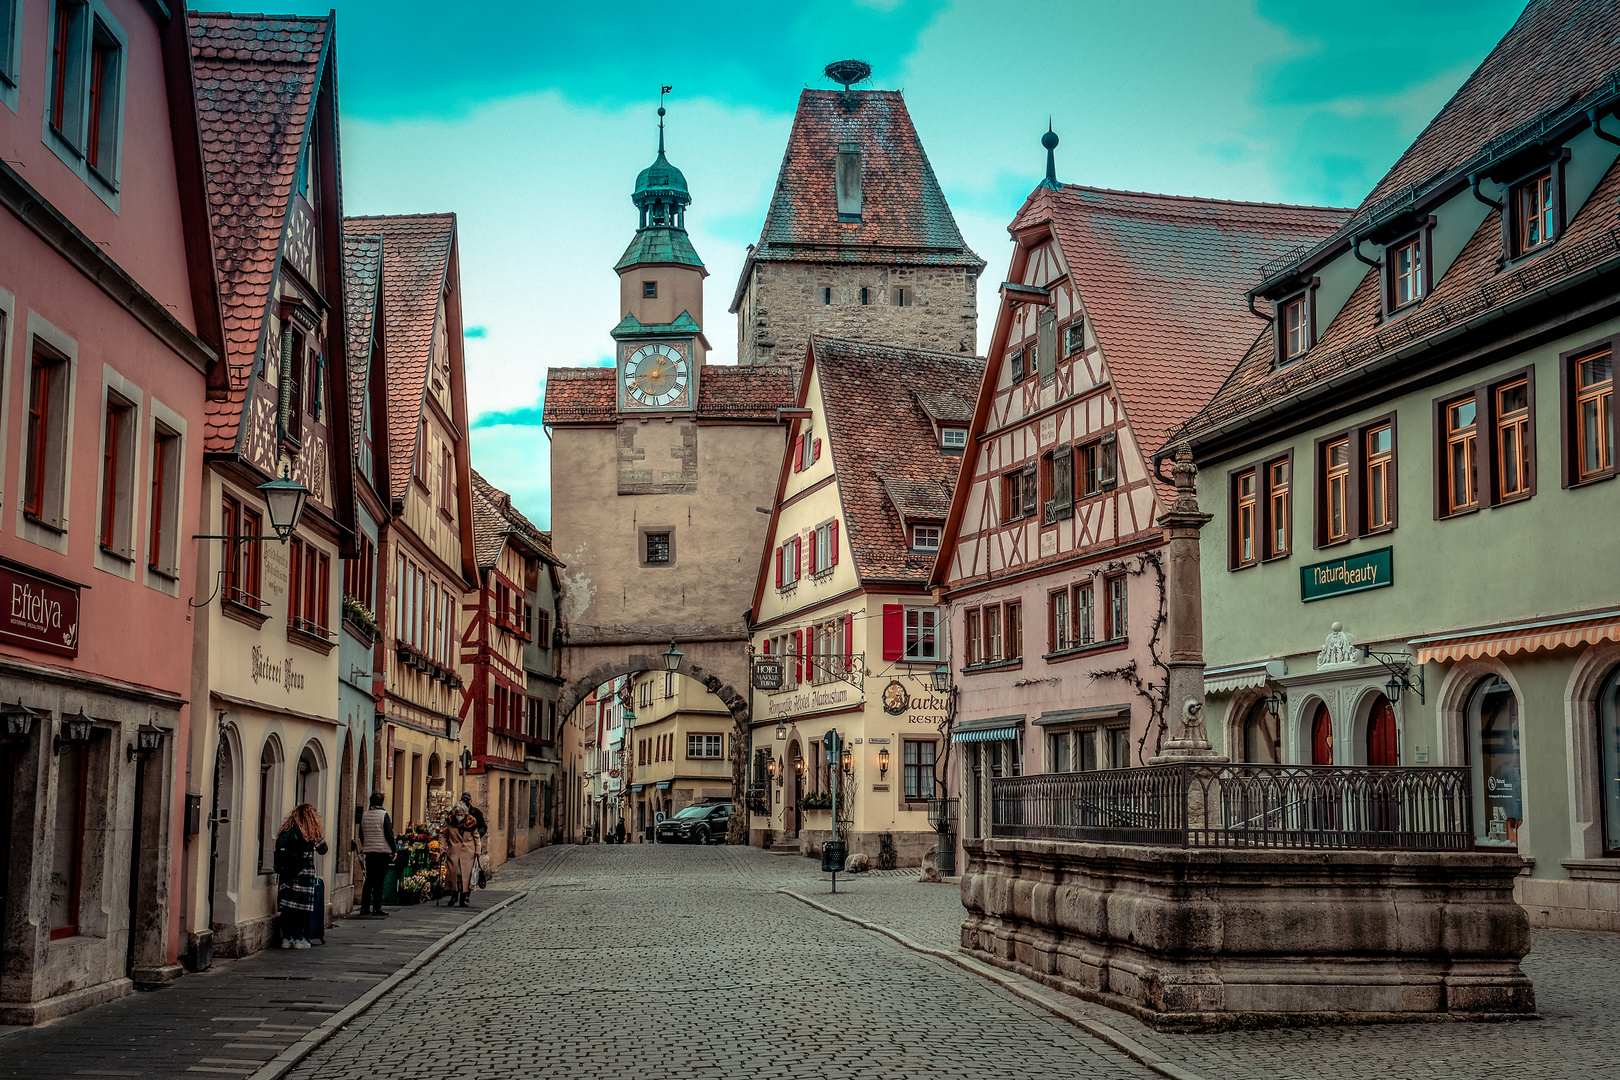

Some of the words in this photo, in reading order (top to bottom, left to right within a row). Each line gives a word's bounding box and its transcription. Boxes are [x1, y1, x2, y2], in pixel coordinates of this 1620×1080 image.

[11, 583, 61, 634] Eftelya
[757, 665, 778, 674] HOTEL
[794, 692, 810, 712] Hotel
[812, 688, 848, 708] Markusturm
